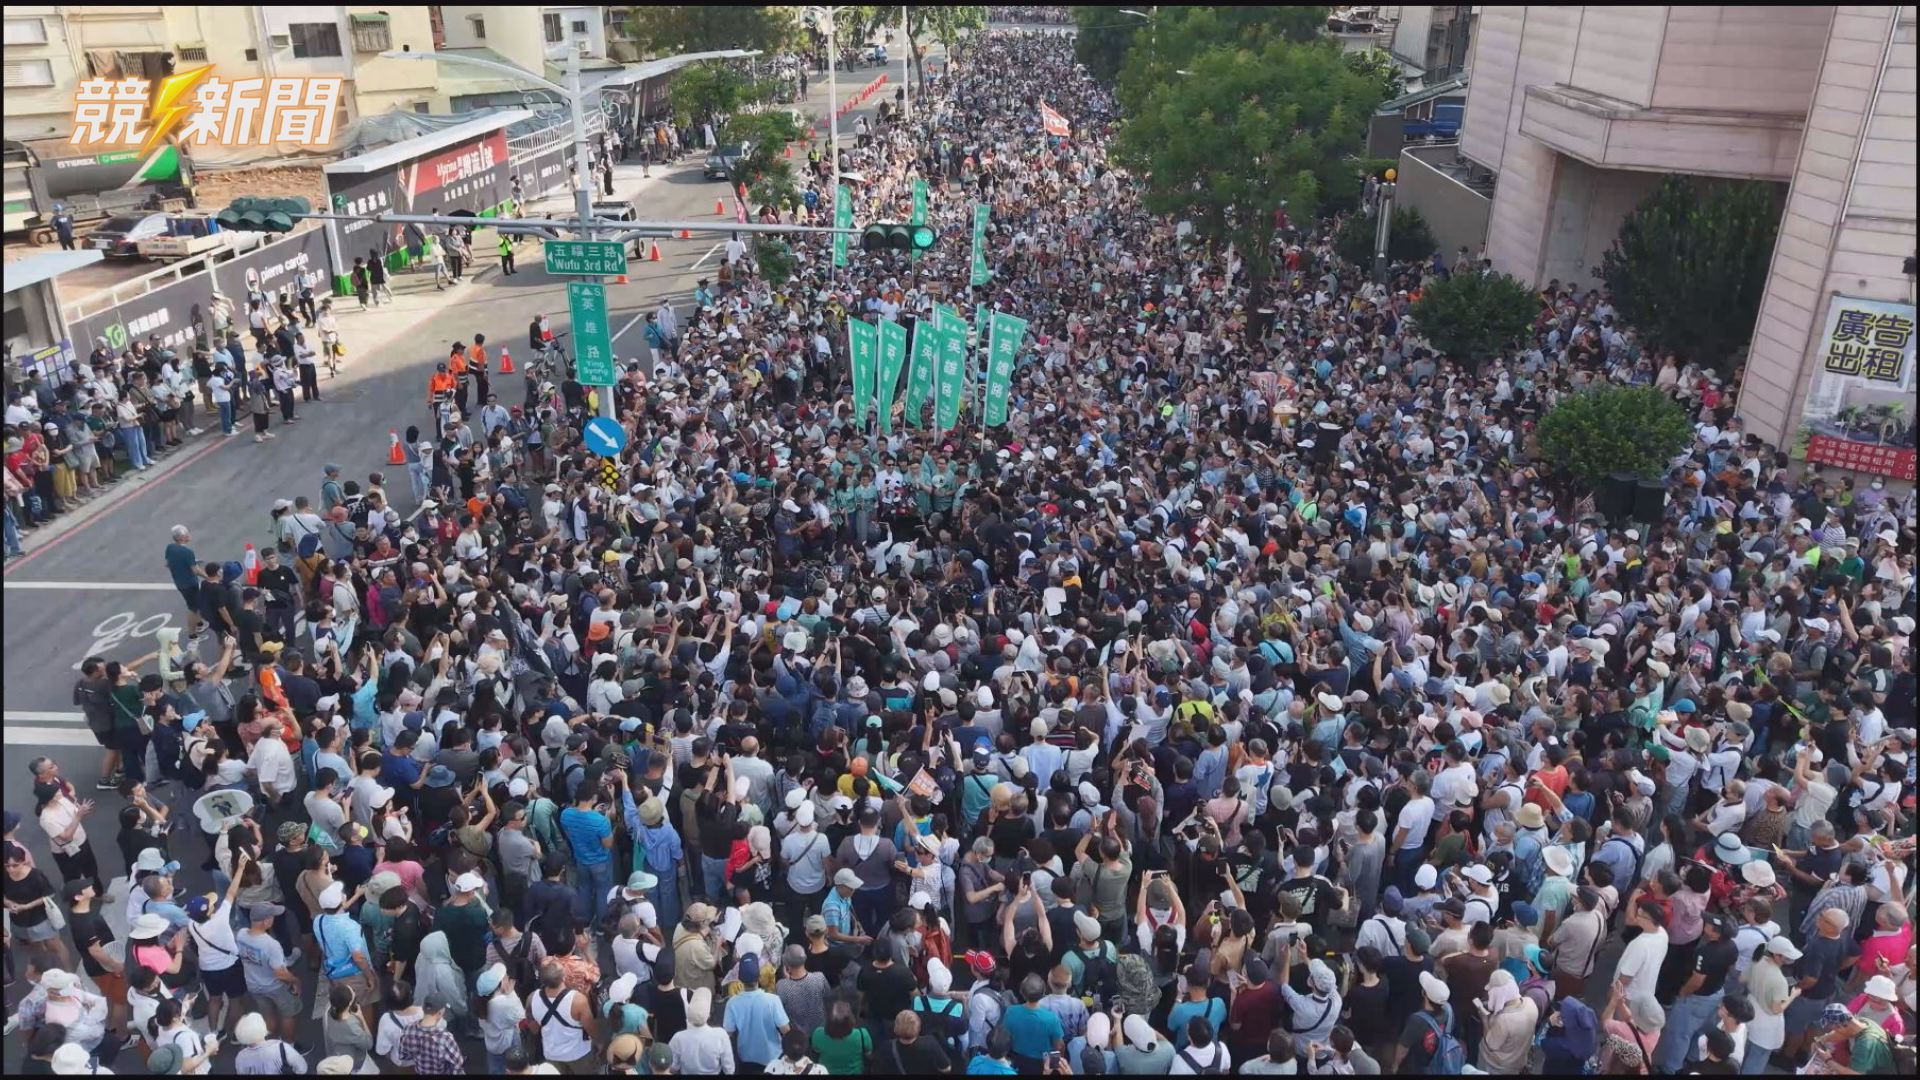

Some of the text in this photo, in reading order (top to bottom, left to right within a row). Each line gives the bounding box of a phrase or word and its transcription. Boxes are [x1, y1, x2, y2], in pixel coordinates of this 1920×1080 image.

[555, 245, 617, 257] 五福三路
[555, 259, 580, 271] Wufu
[584, 260, 601, 271] 3rd
[261, 263, 284, 284] pierre
[582, 298, 600, 359] 英雄路
[1832, 310, 1914, 349] 廣告
[942, 338, 961, 398] 英雄路
[990, 338, 1013, 399] 英雄路
[1825, 342, 1904, 382] 出租
